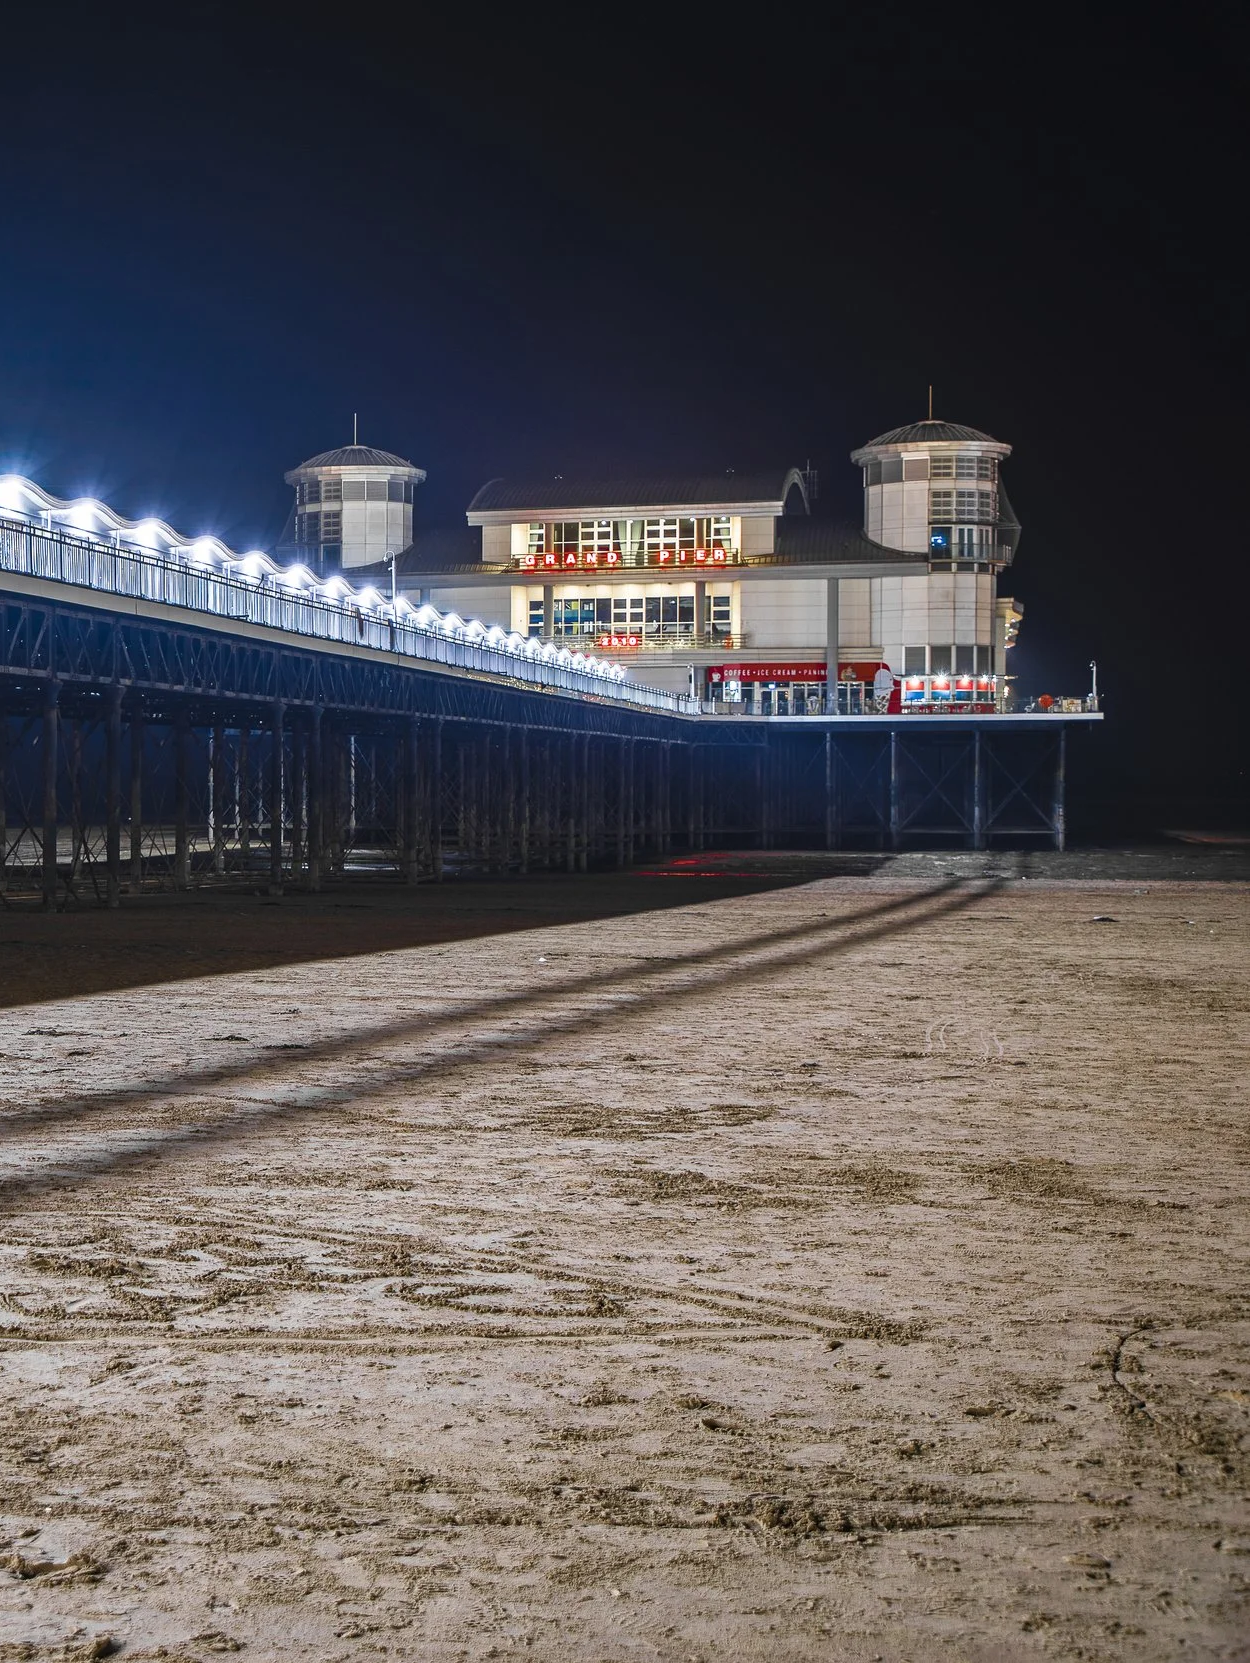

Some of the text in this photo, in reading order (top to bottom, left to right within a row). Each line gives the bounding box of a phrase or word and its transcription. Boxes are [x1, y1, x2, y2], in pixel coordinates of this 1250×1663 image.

[525, 549, 725, 566] GRAND PIER
[601, 637, 637, 646] 2010
